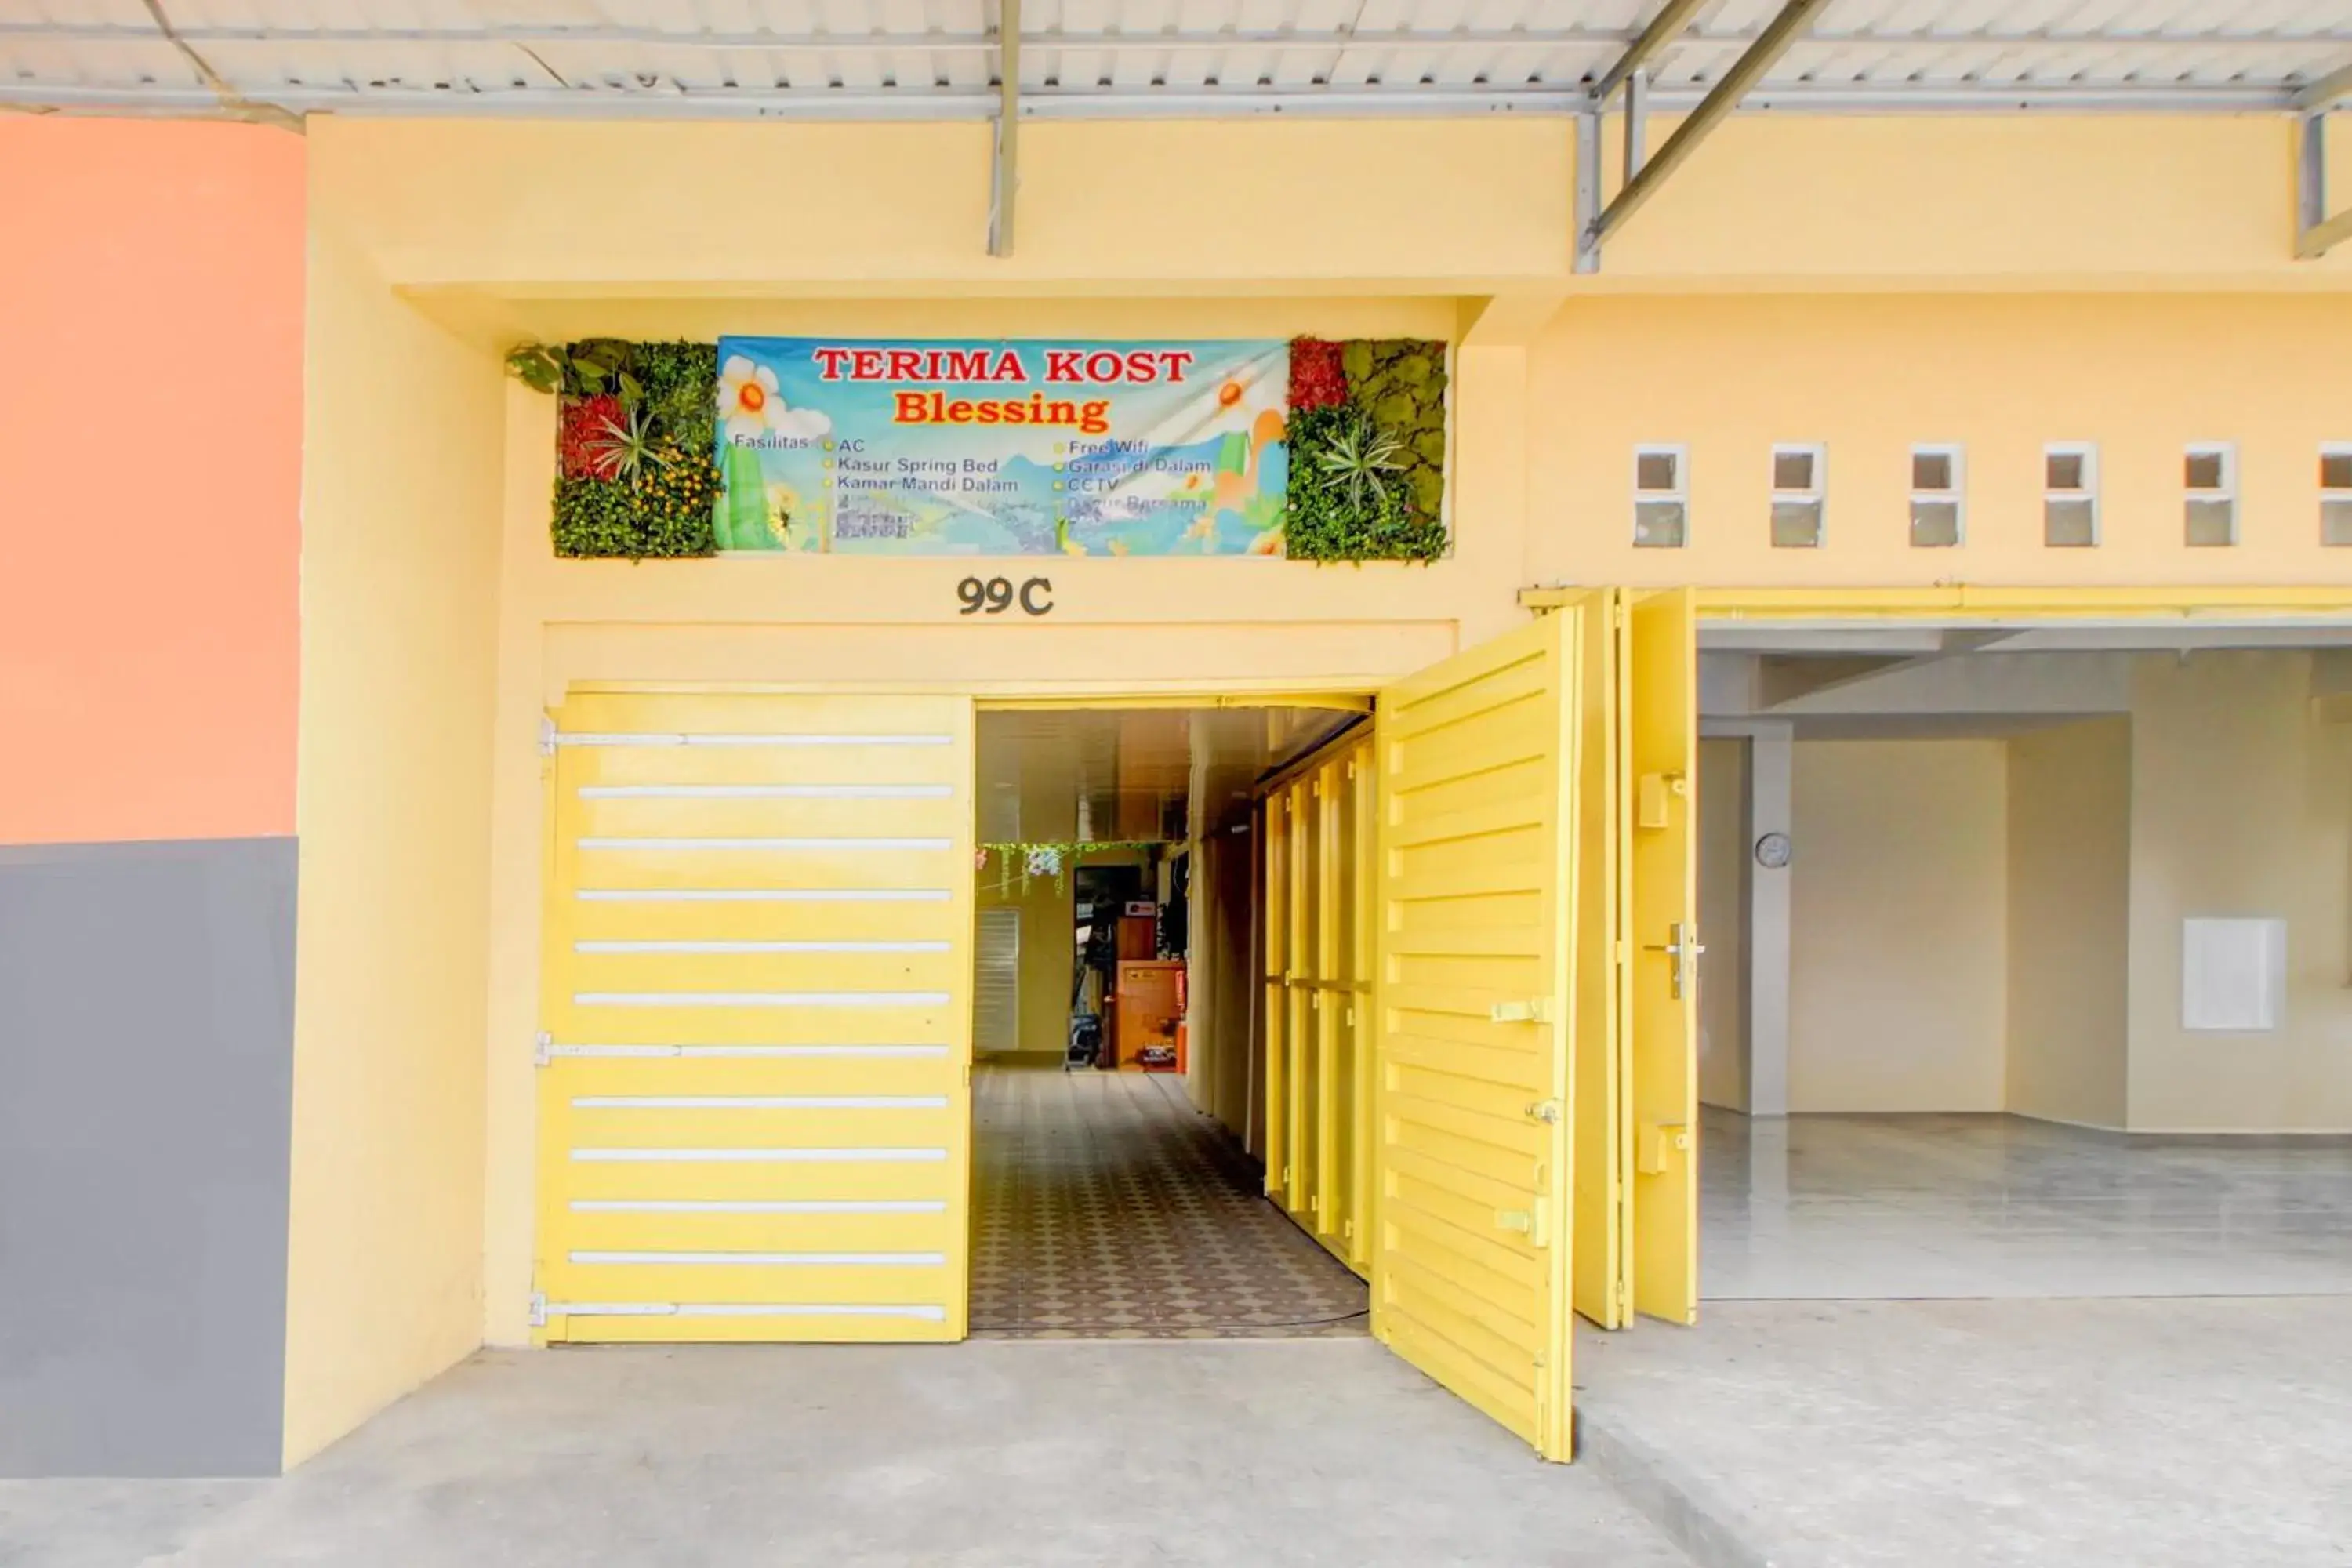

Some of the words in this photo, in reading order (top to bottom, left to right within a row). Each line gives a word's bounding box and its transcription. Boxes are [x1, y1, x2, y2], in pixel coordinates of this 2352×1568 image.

[814, 349, 1027, 382] TERIMA
[1044, 350, 1193, 383] KOST
[894, 391, 1110, 433] Blessing
[734, 434, 808, 449] Fasilitas
[838, 439, 865, 452] AC
[1069, 440, 1109, 454] Free
[837, 457, 891, 472] Kasur
[897, 459, 956, 475] Spring
[963, 459, 998, 473] Bed
[1155, 458, 1211, 472] Dalam
[837, 476, 895, 490] Kamar
[902, 477, 956, 491] Mandi
[962, 477, 1018, 492] Dalam
[1068, 477, 1120, 492] CCTV
[956, 577, 1013, 615] 99
[1019, 577, 1054, 616] C
